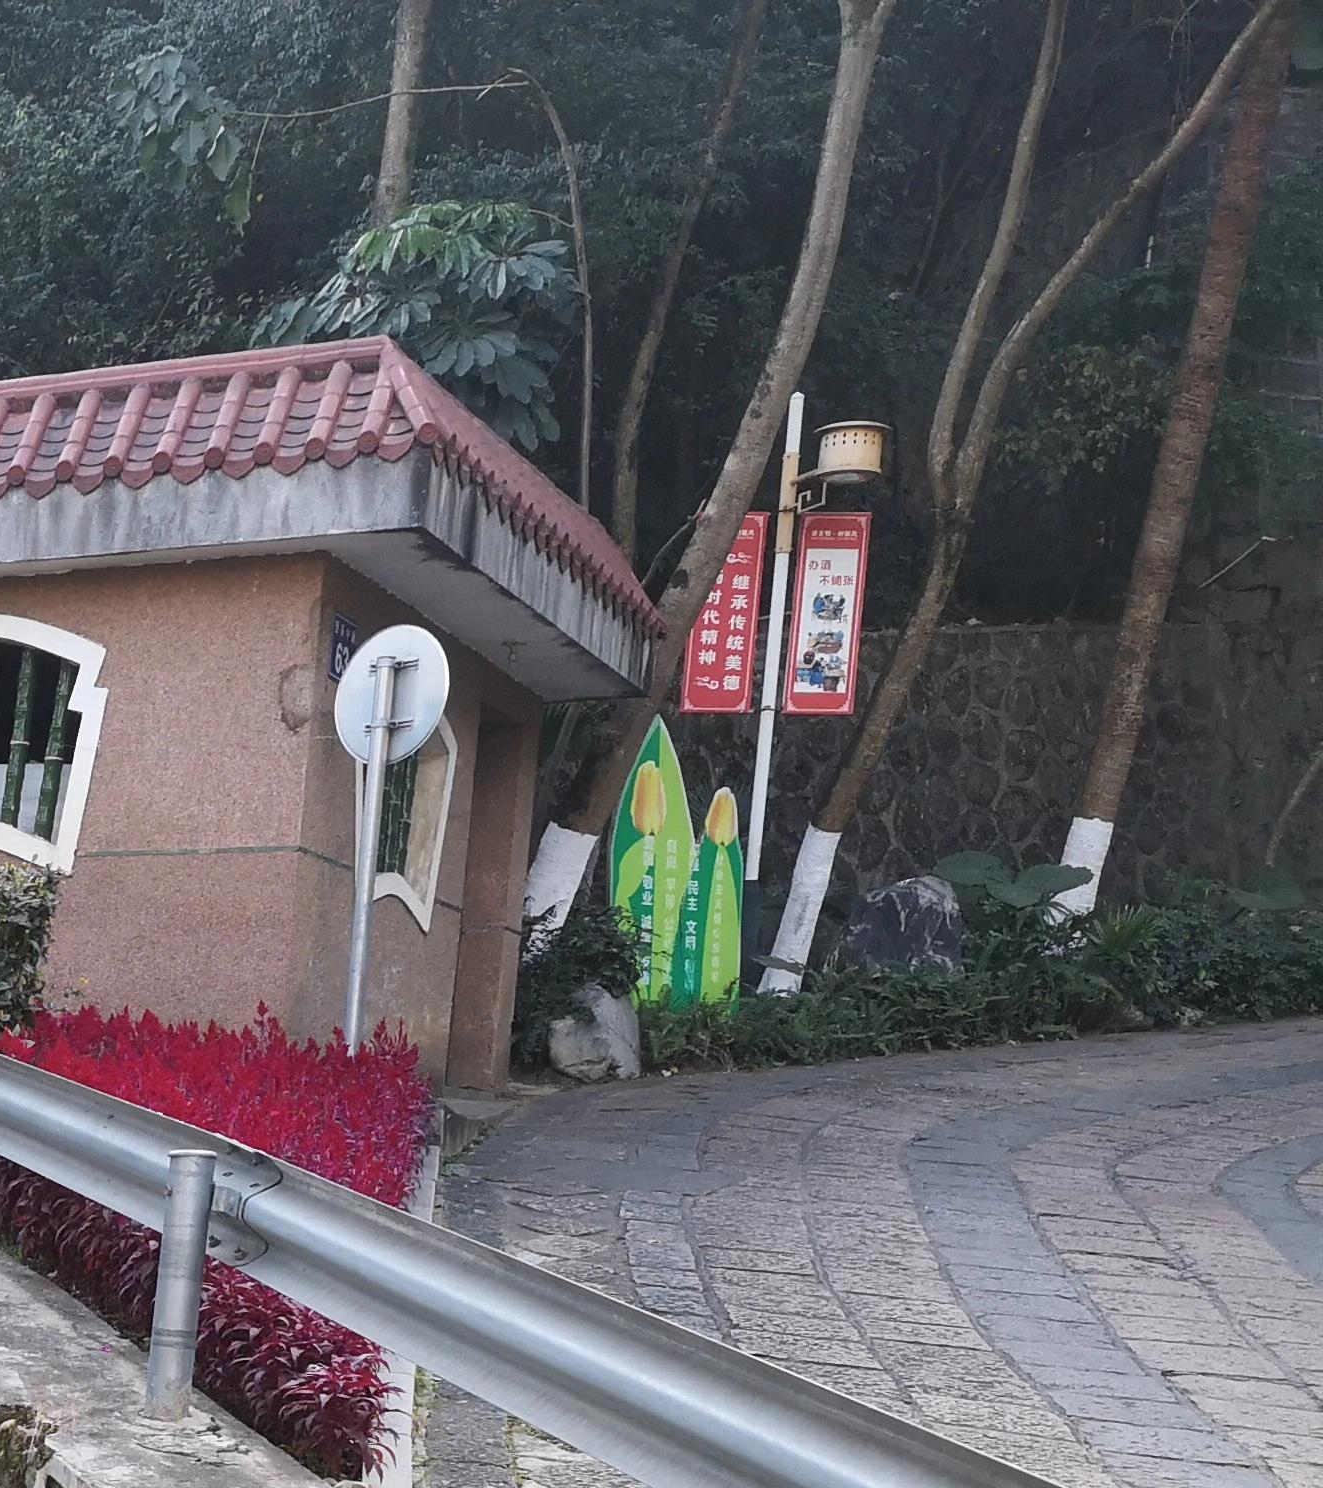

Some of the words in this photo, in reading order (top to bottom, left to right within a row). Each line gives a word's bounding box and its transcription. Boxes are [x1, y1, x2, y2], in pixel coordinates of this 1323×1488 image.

[723, 574, 751, 691] 继承传统美德
